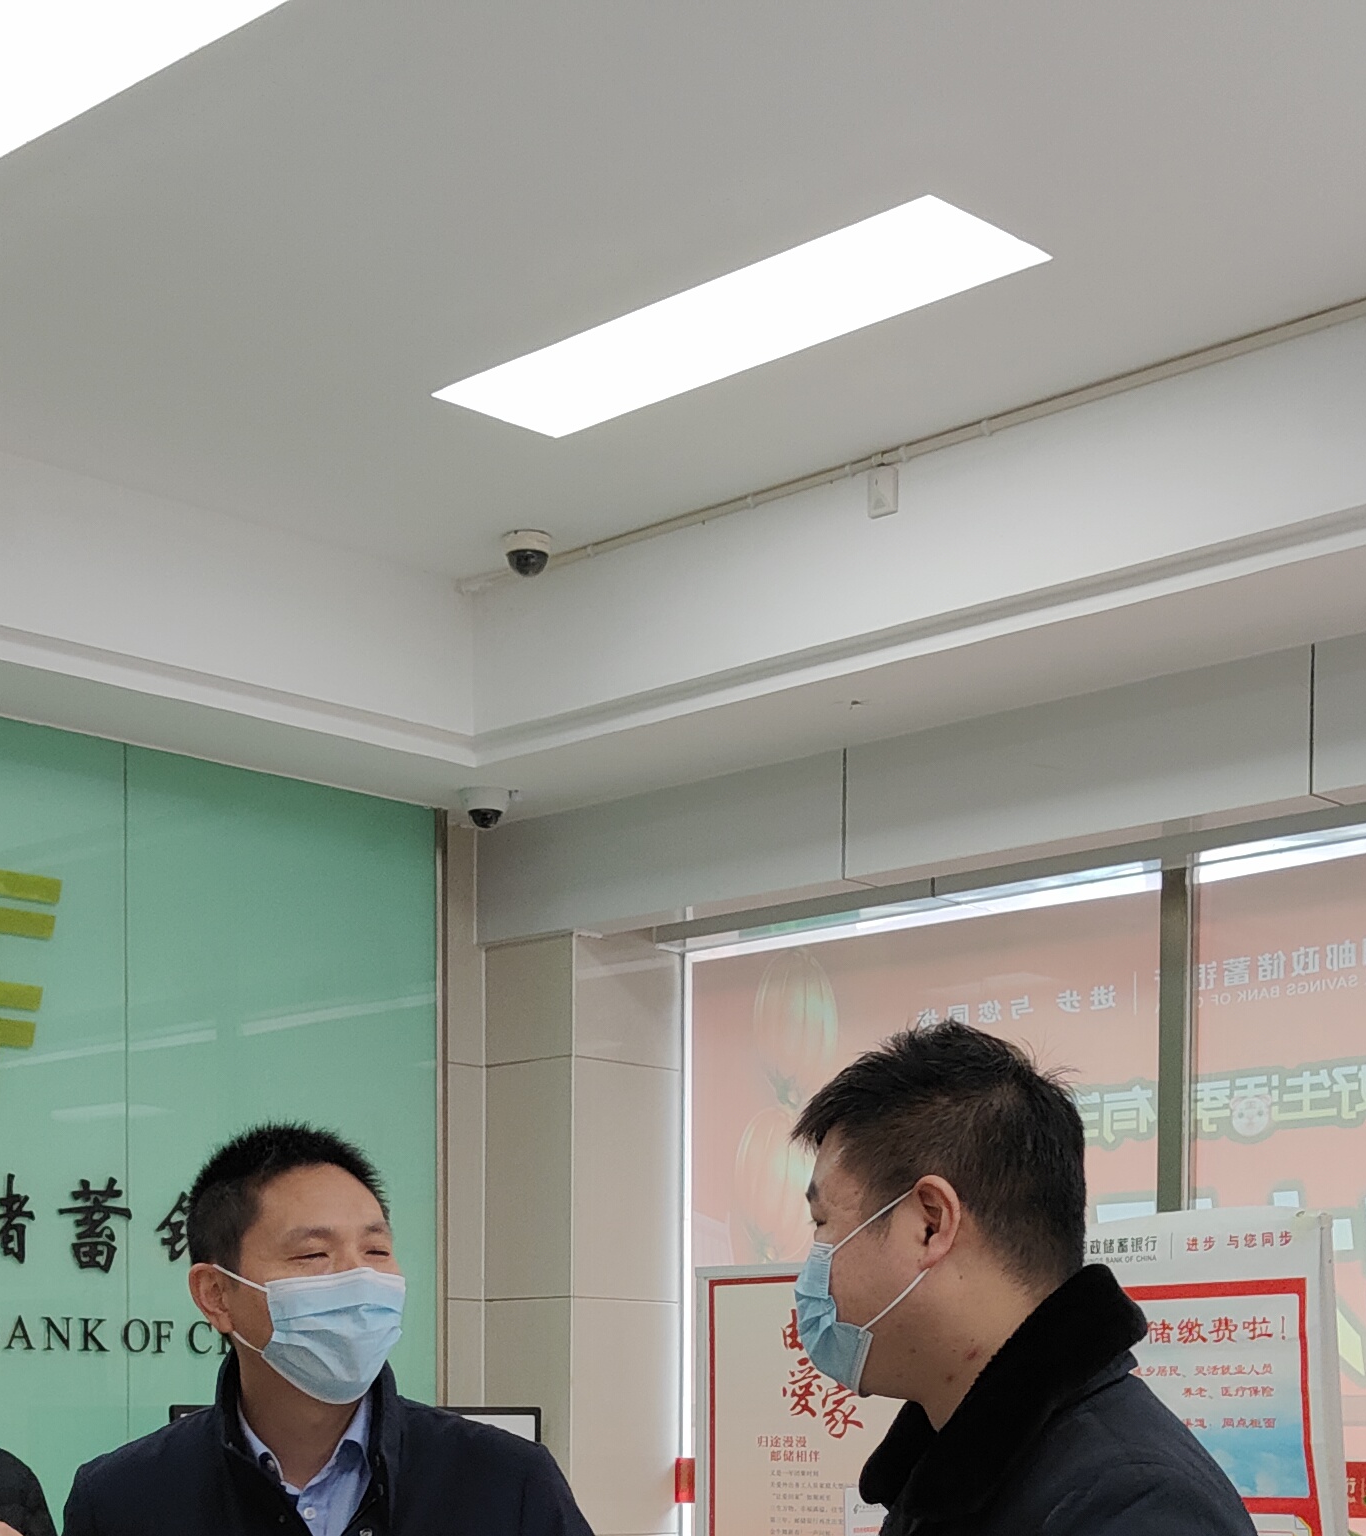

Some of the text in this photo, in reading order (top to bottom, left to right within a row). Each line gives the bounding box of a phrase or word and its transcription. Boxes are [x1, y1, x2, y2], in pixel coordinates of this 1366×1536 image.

[1186, 1236, 1215, 1251] 进步
[1227, 1230, 1292, 1249] 与您同步
[121, 1318, 174, 1355] OF
[757, 1435, 807, 1448] 归途漫漫
[770, 1450, 820, 1462] 邮储相伴
